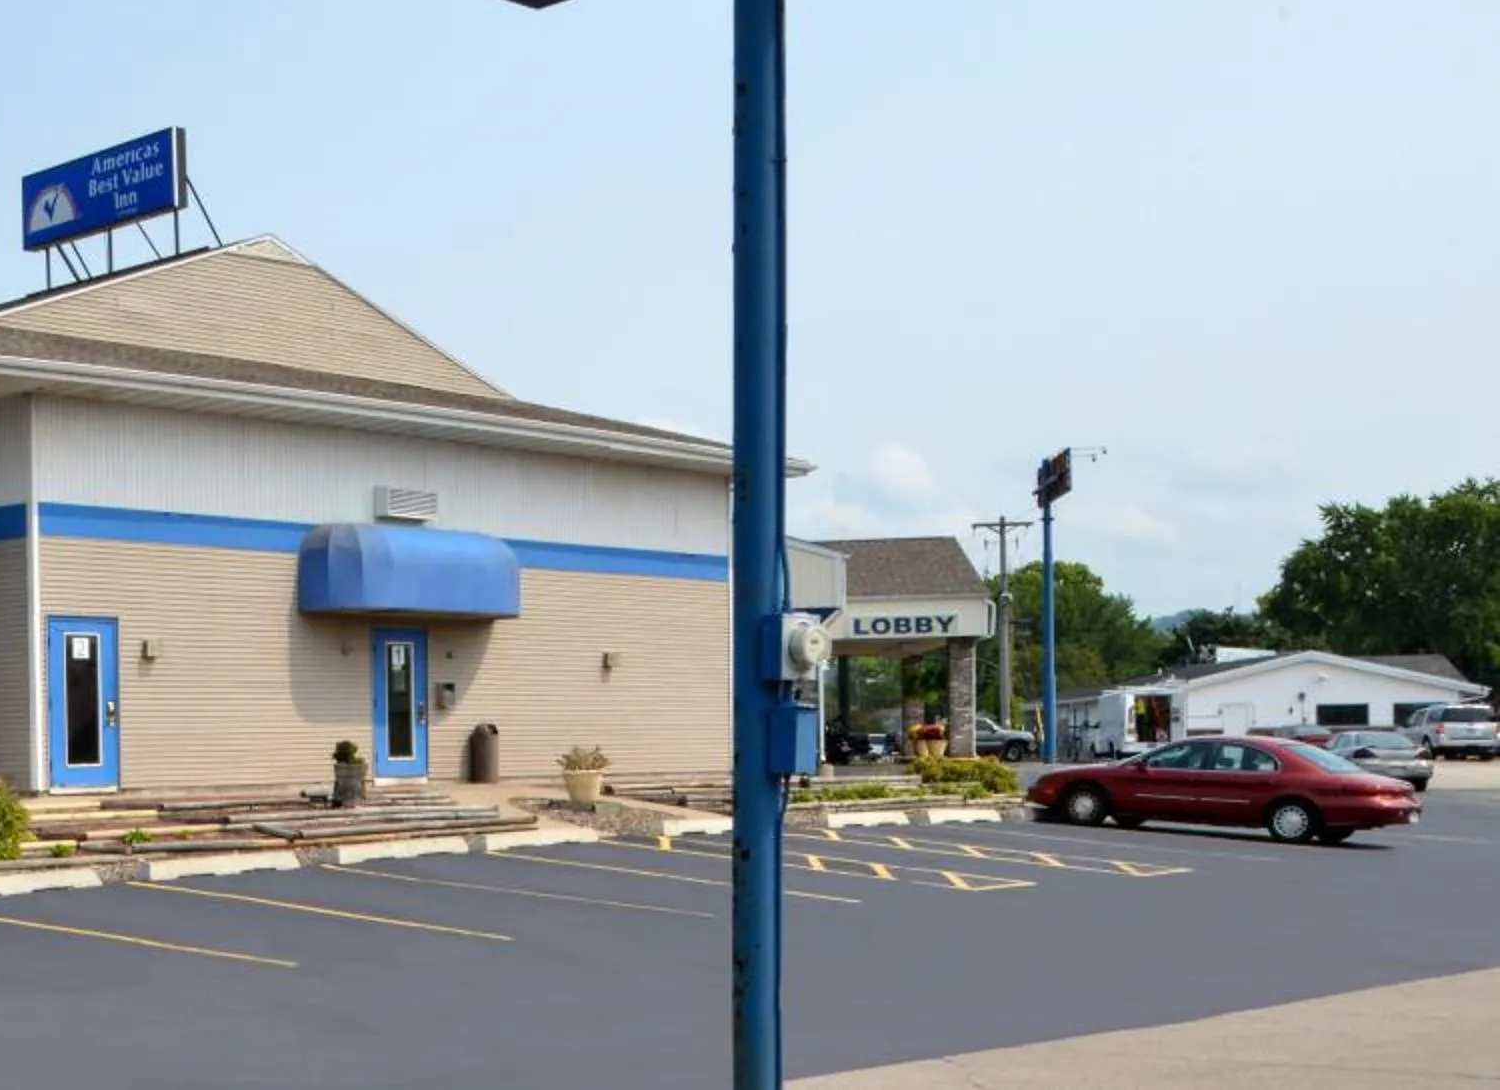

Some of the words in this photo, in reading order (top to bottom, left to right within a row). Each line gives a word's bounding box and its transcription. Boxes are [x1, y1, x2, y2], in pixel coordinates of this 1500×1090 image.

[91, 141, 160, 176] Americas
[89, 173, 118, 198] Best
[121, 161, 163, 185] Value
[114, 190, 138, 209] Inn
[853, 615, 957, 636] LOBBY
